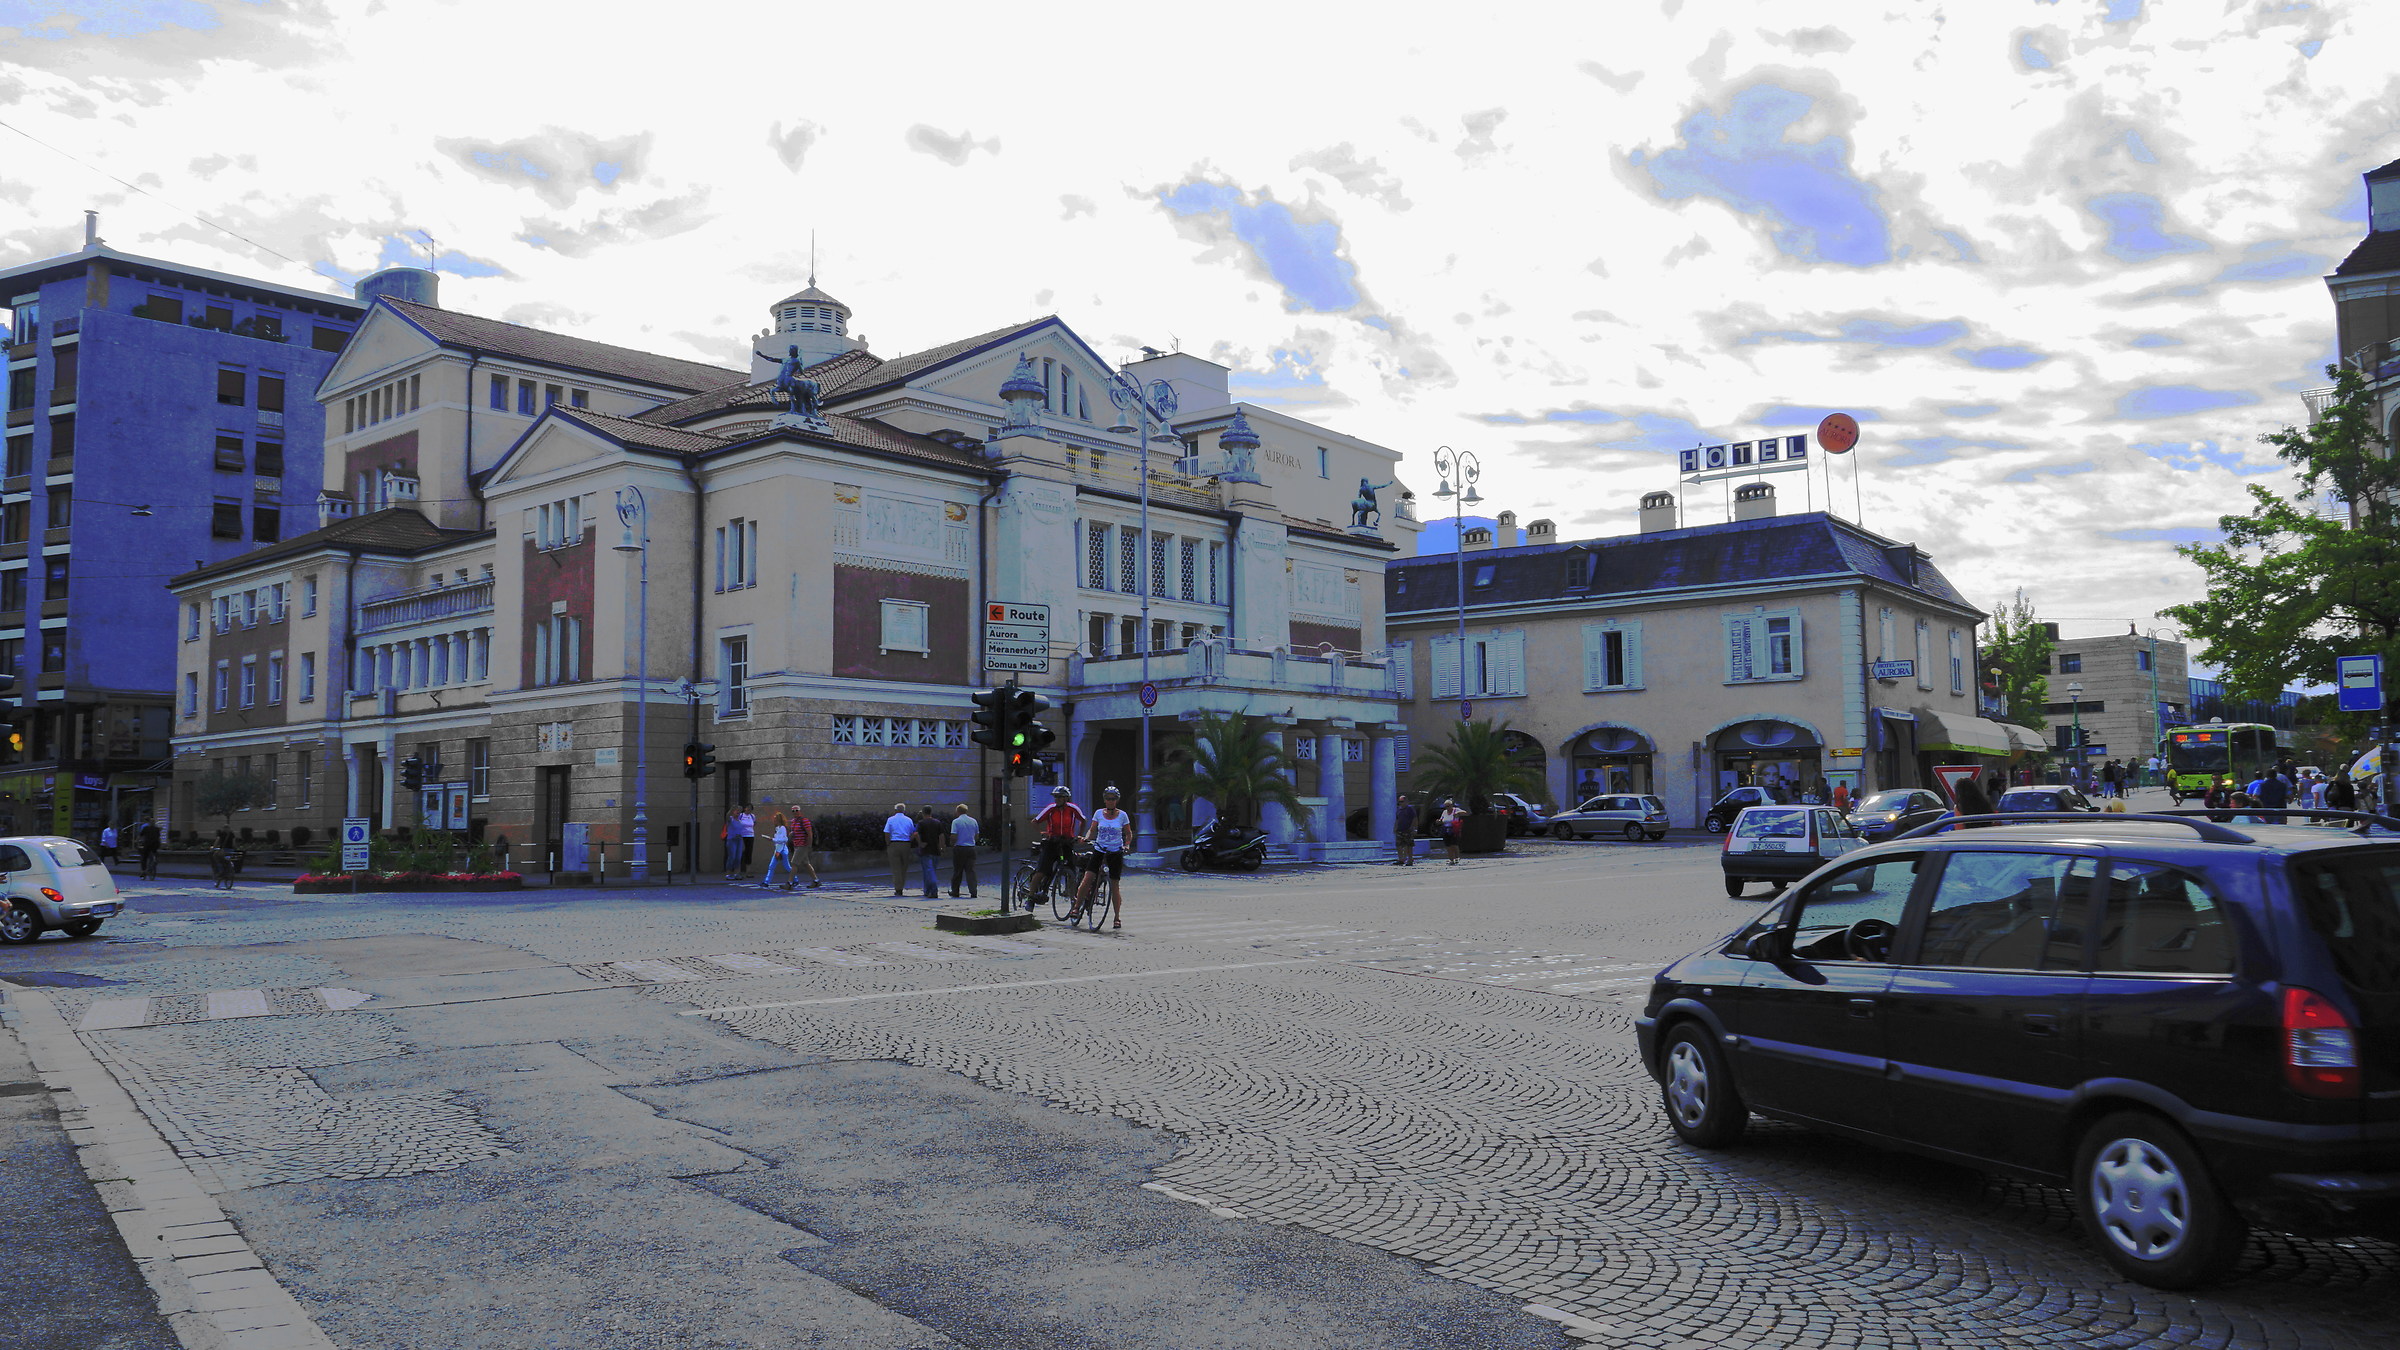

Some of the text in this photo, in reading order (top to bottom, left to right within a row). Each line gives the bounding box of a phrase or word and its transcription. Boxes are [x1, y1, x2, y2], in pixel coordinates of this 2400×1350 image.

[1264, 450, 1302, 470] AURORA
[1681, 438, 1803, 471] HOTEL
[1010, 609, 1045, 621] Route
[989, 630, 1019, 639] Aurora
[989, 645, 1038, 655] Meranerhof
[988, 660, 1037, 670] Domus Mea
[1878, 667, 1911, 676] AURORA
[84, 775, 104, 787] toys
